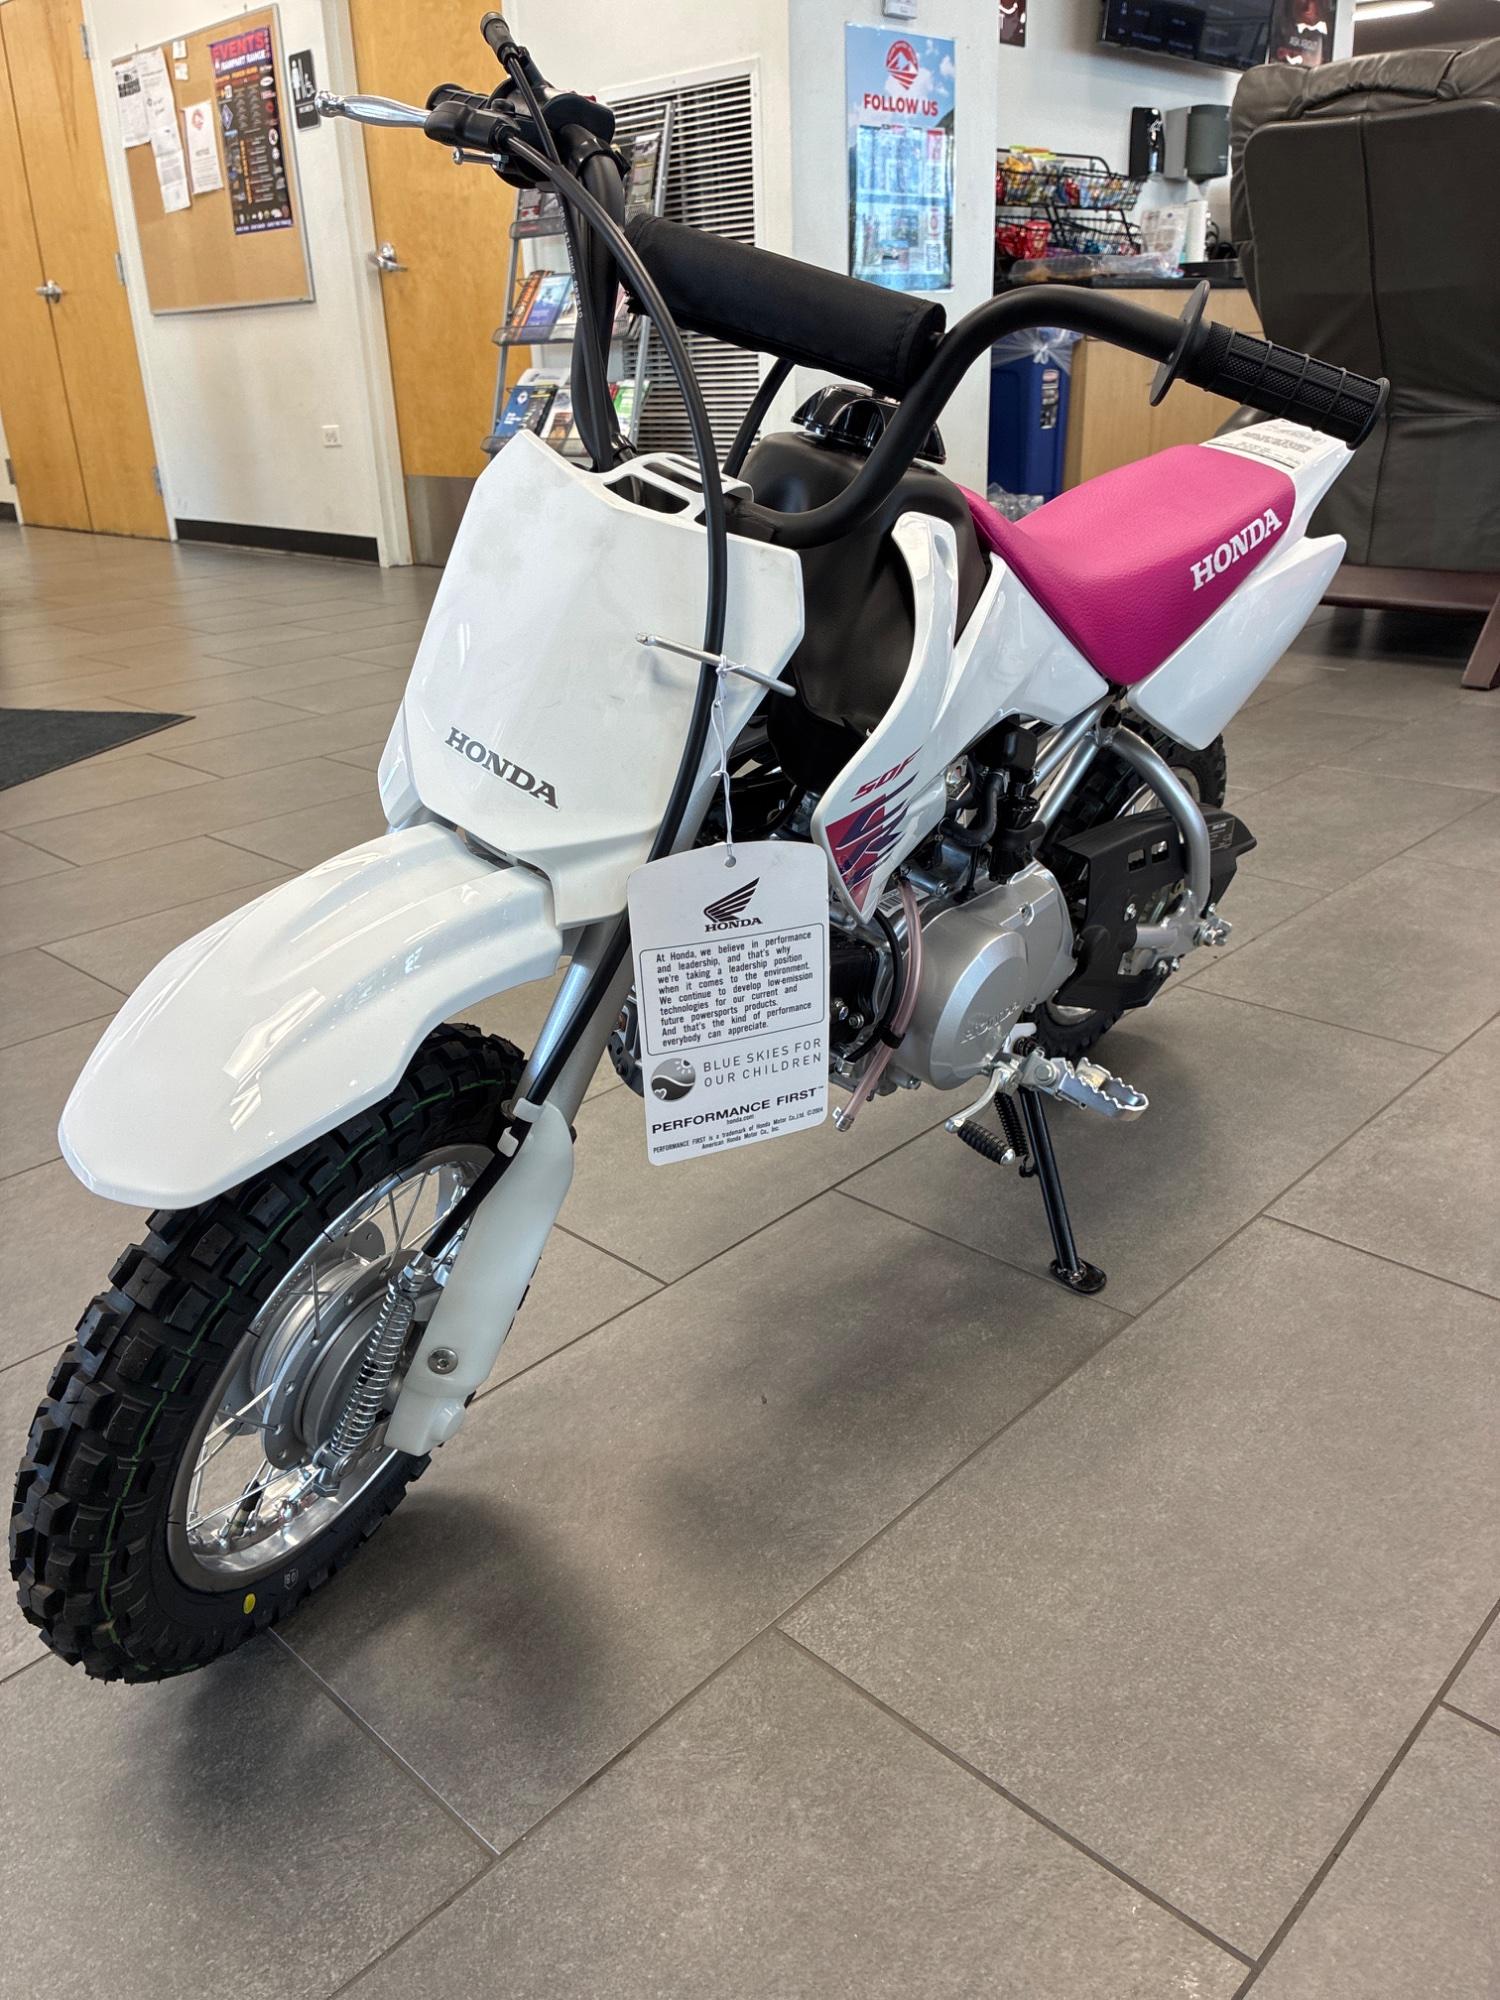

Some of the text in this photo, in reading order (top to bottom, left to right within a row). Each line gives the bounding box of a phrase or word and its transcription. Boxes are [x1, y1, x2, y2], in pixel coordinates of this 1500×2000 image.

[211, 31, 265, 62] EVENTS
[864, 93, 938, 117] FOLLOW US
[1190, 508, 1283, 592] HONDA
[445, 726, 559, 809] HONDA
[704, 917, 763, 932] HONDA
[656, 953, 665, 963] At
[700, 949, 711, 957] we
[718, 943, 745, 954] believe
[751, 939, 759, 948] in
[765, 931, 811, 948] performance
[657, 964, 671, 973] and
[727, 954, 741, 963] and
[747, 949, 770, 960] that's
[776, 945, 791, 955] why
[657, 974, 680, 984] we're
[686, 970, 710, 981] taking
[728, 959, 767, 973] leadership
[774, 953, 802, 966] position
[658, 985, 679, 995] when
[686, 982, 692, 990] it
[699, 979, 724, 989] comes
[730, 975, 738, 984] to
[745, 972, 757, 981] the
[659, 971, 813, 1005] We continue to develop low-emission
[660, 985, 798, 1016] technologies for our current and
[660, 999, 778, 1026] future powersports products.
[662, 1001, 812, 1037] And that's the kind of performance
[662, 1021, 769, 1047] everybody can appreciate.
[703, 1038, 821, 1072] BLUE SKIES FOR
[704, 1052, 821, 1087] OUR CHILDREN
[652, 1099, 771, 1134] PERFORMANCE
[726, 1114, 755, 1125] honda.com
[653, 1140, 689, 1154] PERFORMANCE
[692, 1136, 706, 1145] FIRST
[721, 1127, 746, 1138] trademark
[773, 1117, 787, 1125] Motor
[702, 1140, 724, 1149] American
[743, 1131, 758, 1139] Motor
